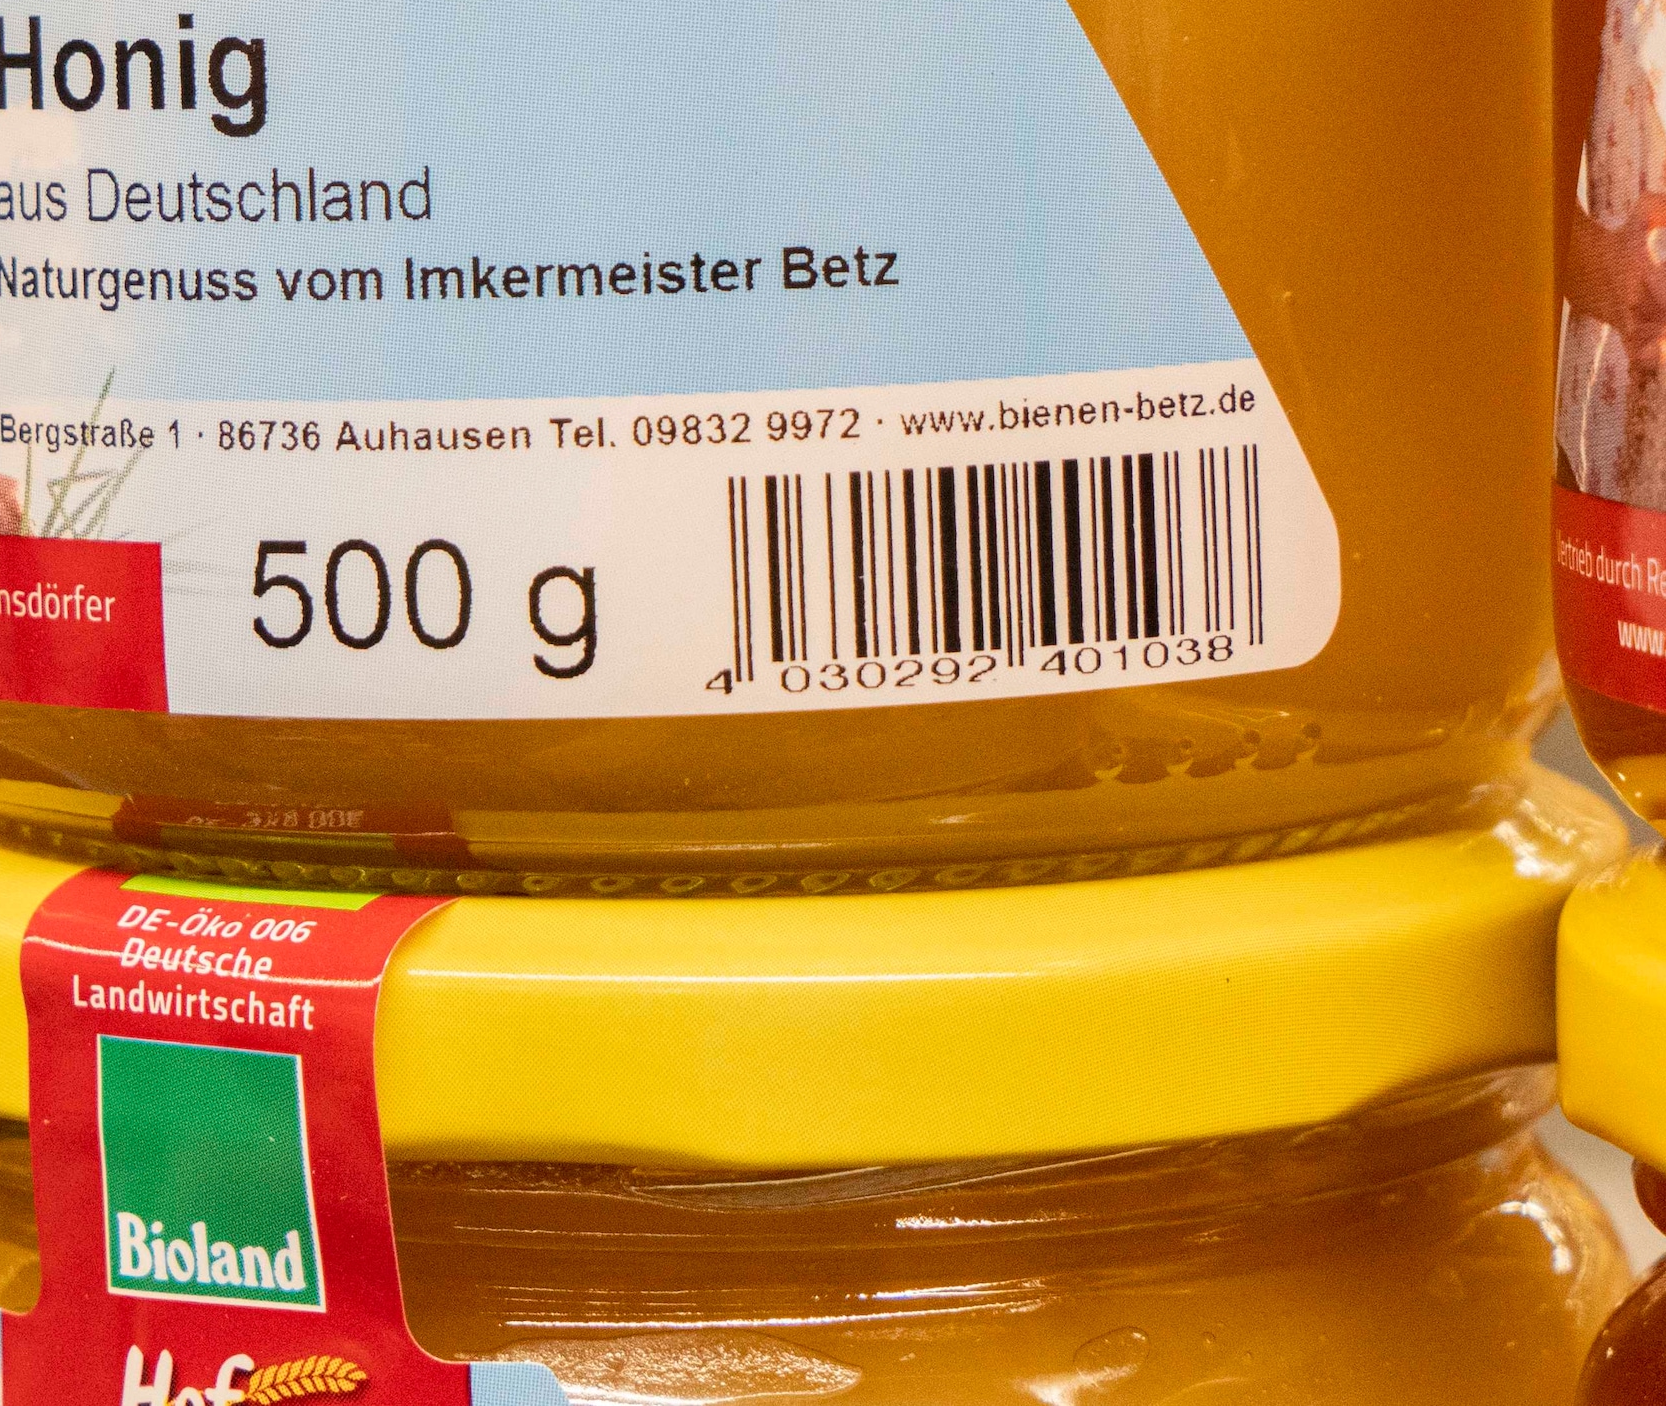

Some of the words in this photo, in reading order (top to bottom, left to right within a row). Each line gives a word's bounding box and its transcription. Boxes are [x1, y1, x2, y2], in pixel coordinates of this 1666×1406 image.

[86, 166, 433, 223] Deutschland
[275, 266, 384, 302] vom
[405, 250, 763, 300] Imkermeister
[780, 244, 900, 291] Betz
[0, 414, 156, 453] Bergstraße
[168, 421, 181, 449] 1
[218, 419, 321, 451] 86736
[335, 419, 532, 452] Auhausen
[550, 417, 616, 449] Tel.
[632, 412, 752, 448] 09832
[766, 407, 863, 443] 9972
[900, 383, 1257, 435] www.bienen-betz.de
[1595, 545, 1642, 592] durch
[252, 538, 473, 650] 500
[528, 565, 598, 679] g
[704, 667, 735, 695] 4
[780, 654, 1000, 695] 030292
[1039, 634, 1235, 677] 401038
[116, 903, 245, 940] DE-Öko
[249, 916, 317, 944] 006
[119, 936, 273, 981] Deutsche
[72, 974, 315, 1031] Landwirtschaft
[116, 1211, 307, 1293] Bioland
